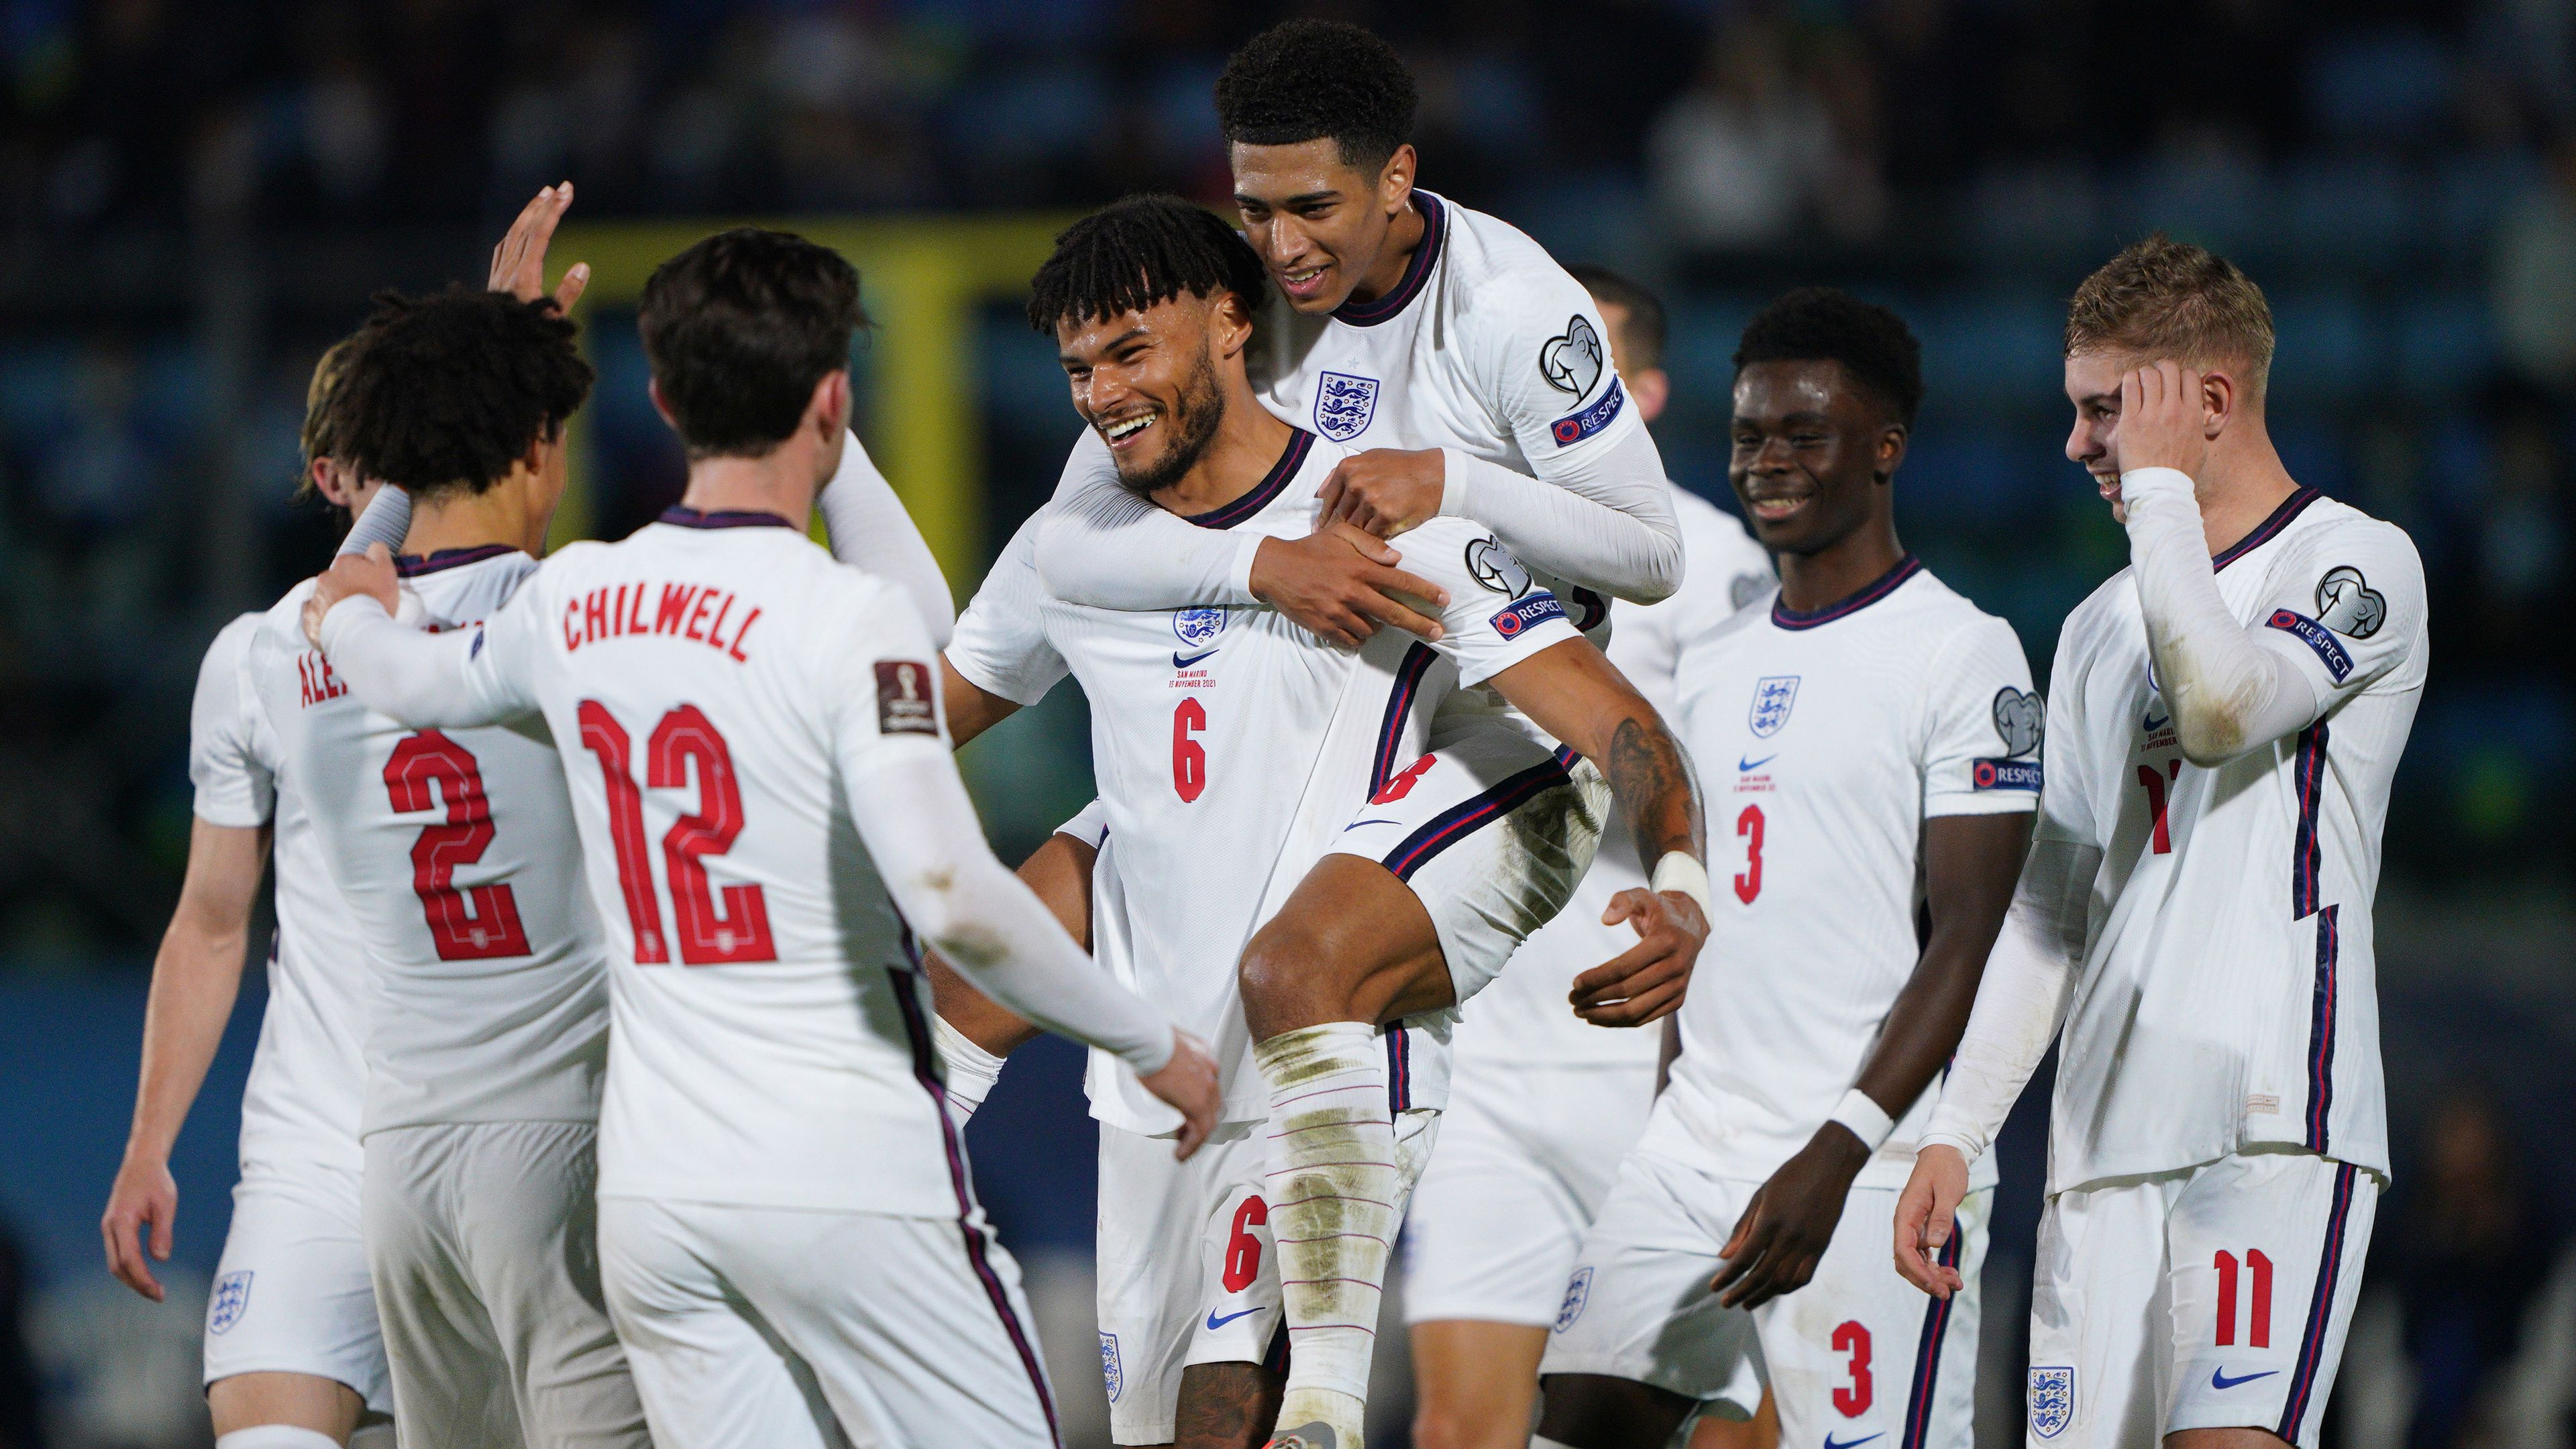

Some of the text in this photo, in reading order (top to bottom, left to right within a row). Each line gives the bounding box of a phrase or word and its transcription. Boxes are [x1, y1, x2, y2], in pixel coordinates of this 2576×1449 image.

[564, 582, 761, 663] CHILWELL
[1517, 600, 1562, 621] RESPECT
[2296, 621, 2349, 675] RESPECT
[1175, 680, 1201, 688] NOVEMBER
[1189, 669, 1208, 678] MARINO
[1173, 697, 1206, 804] 6
[383, 727, 532, 961] 2
[578, 698, 777, 966] 12
[1734, 804, 1765, 906] 3
[1222, 1195, 1268, 1294] 6
[2213, 1248, 2273, 1348] 11
[1831, 1320, 1872, 1418] 3
